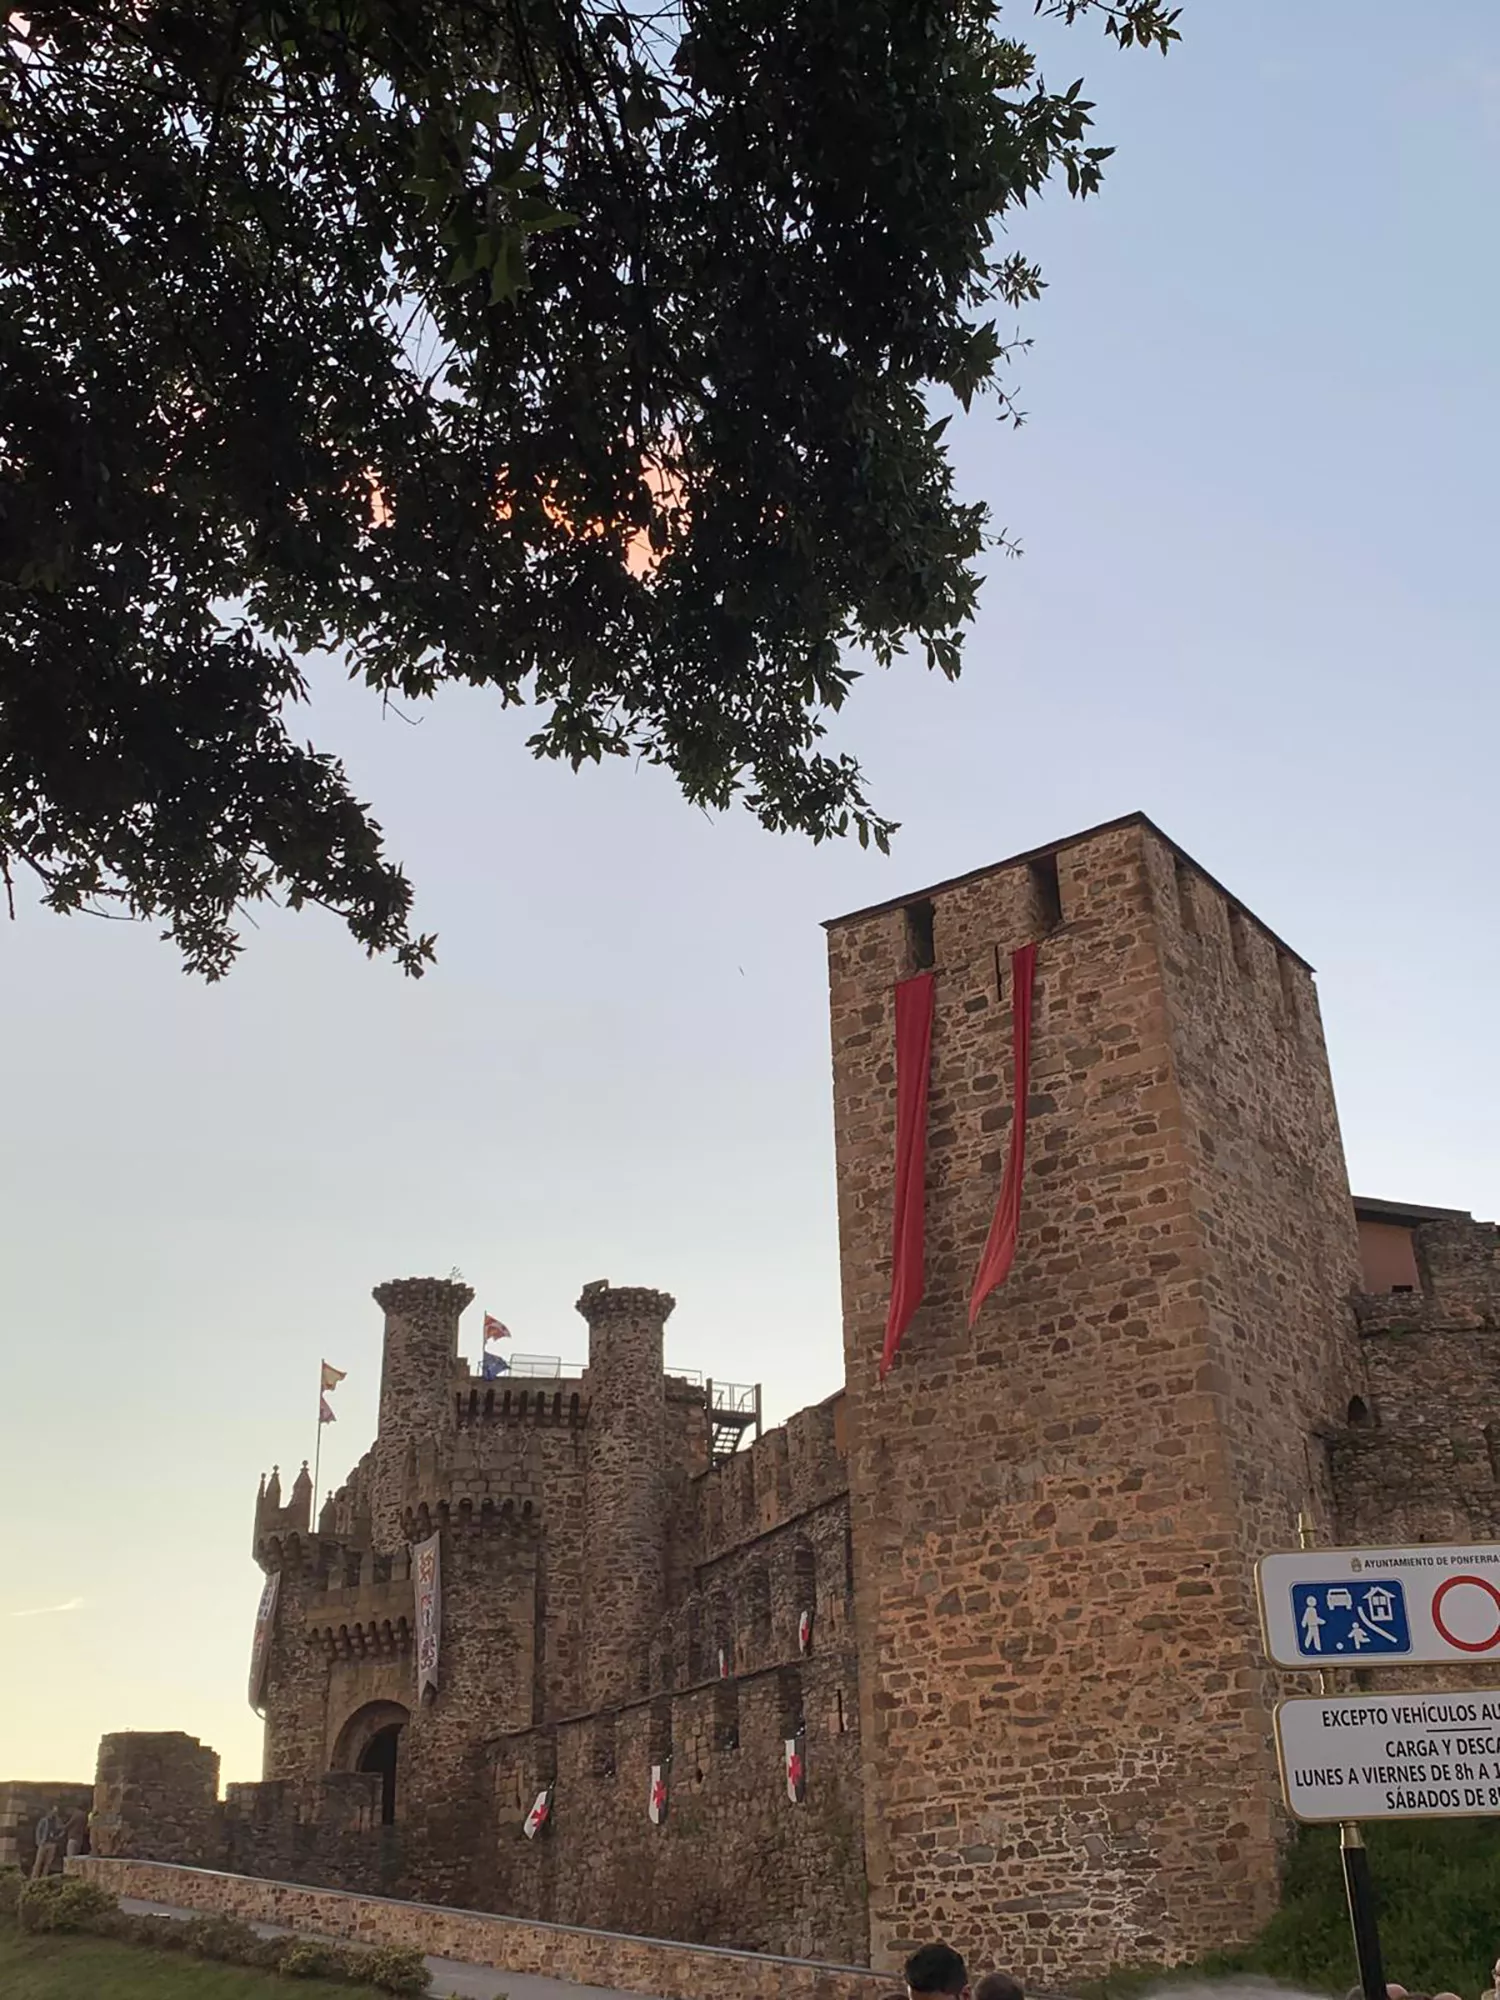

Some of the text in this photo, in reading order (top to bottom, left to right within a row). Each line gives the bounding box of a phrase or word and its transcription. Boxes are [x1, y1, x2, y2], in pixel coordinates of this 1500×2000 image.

[1364, 1555, 1500, 1568] AYUNTAMIENTO DE PONFERRA
[1322, 1708, 1388, 1727] EXCEPTO
[1391, 1702, 1476, 1724] VEHÍCULOS
[1386, 1740, 1439, 1758] CARGA
[1442, 1740, 1451, 1755] Y
[1295, 1768, 1343, 1787] LUNES
[1348, 1767, 1359, 1784] A
[1362, 1765, 1426, 1784] VIERNES
[1431, 1764, 1451, 1781] DE
[1455, 1762, 1474, 1780] 8h
[1479, 1763, 1489, 1779] A
[1386, 1787, 1500, 1809] SÁBADOS DE 8
